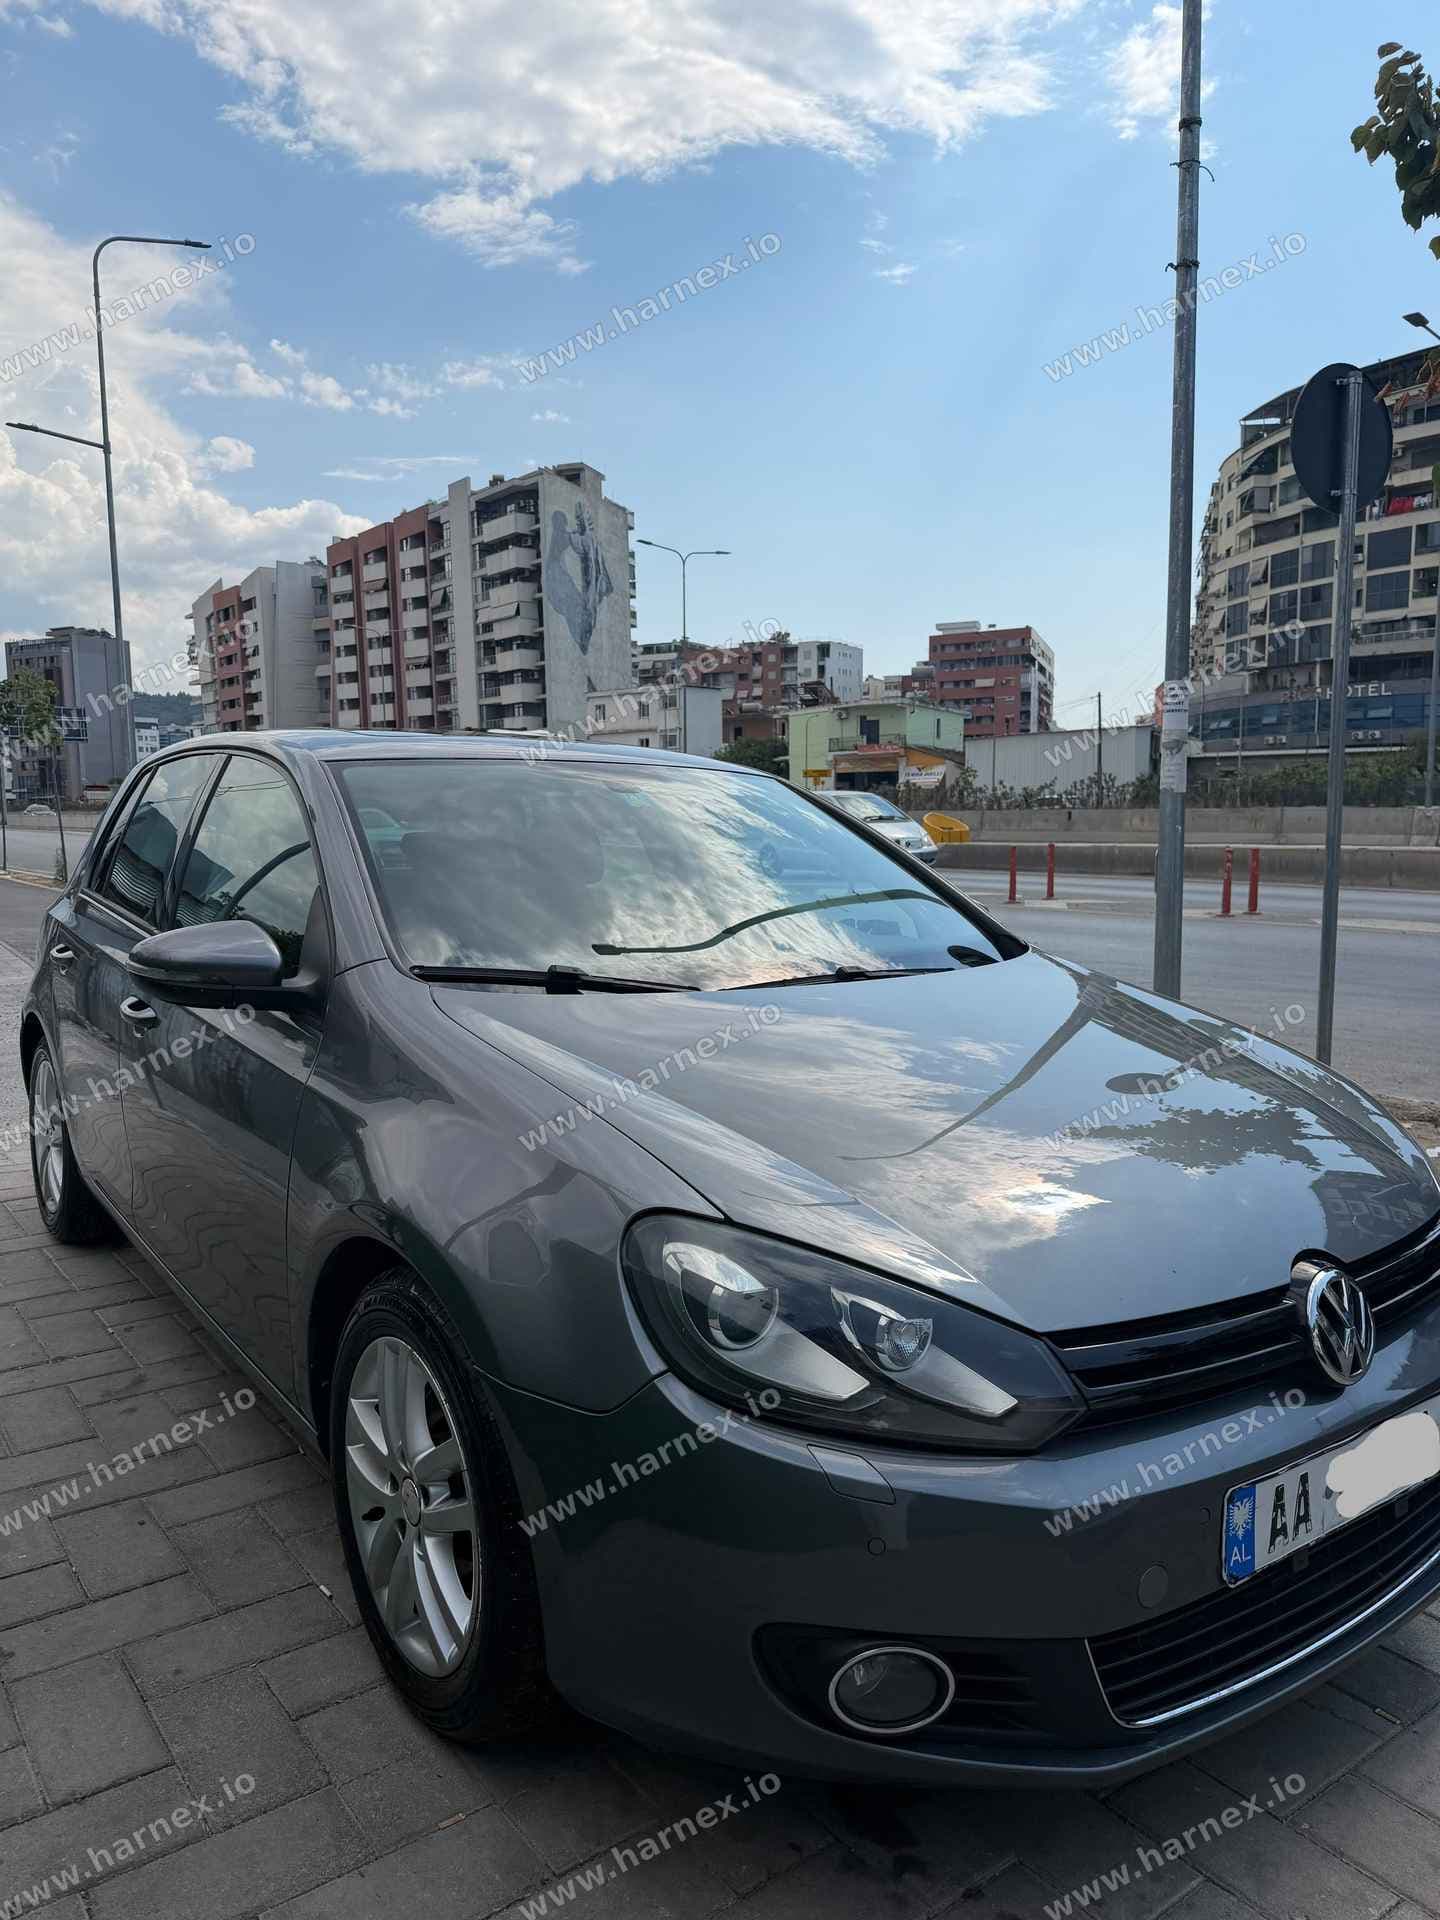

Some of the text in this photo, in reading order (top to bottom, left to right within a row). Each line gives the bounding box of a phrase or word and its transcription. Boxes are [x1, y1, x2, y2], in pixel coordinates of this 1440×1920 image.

[1326, 681, 1392, 699] HTEL
[1268, 1472, 1313, 1554] AA
[1230, 1544, 1251, 1566] AL
